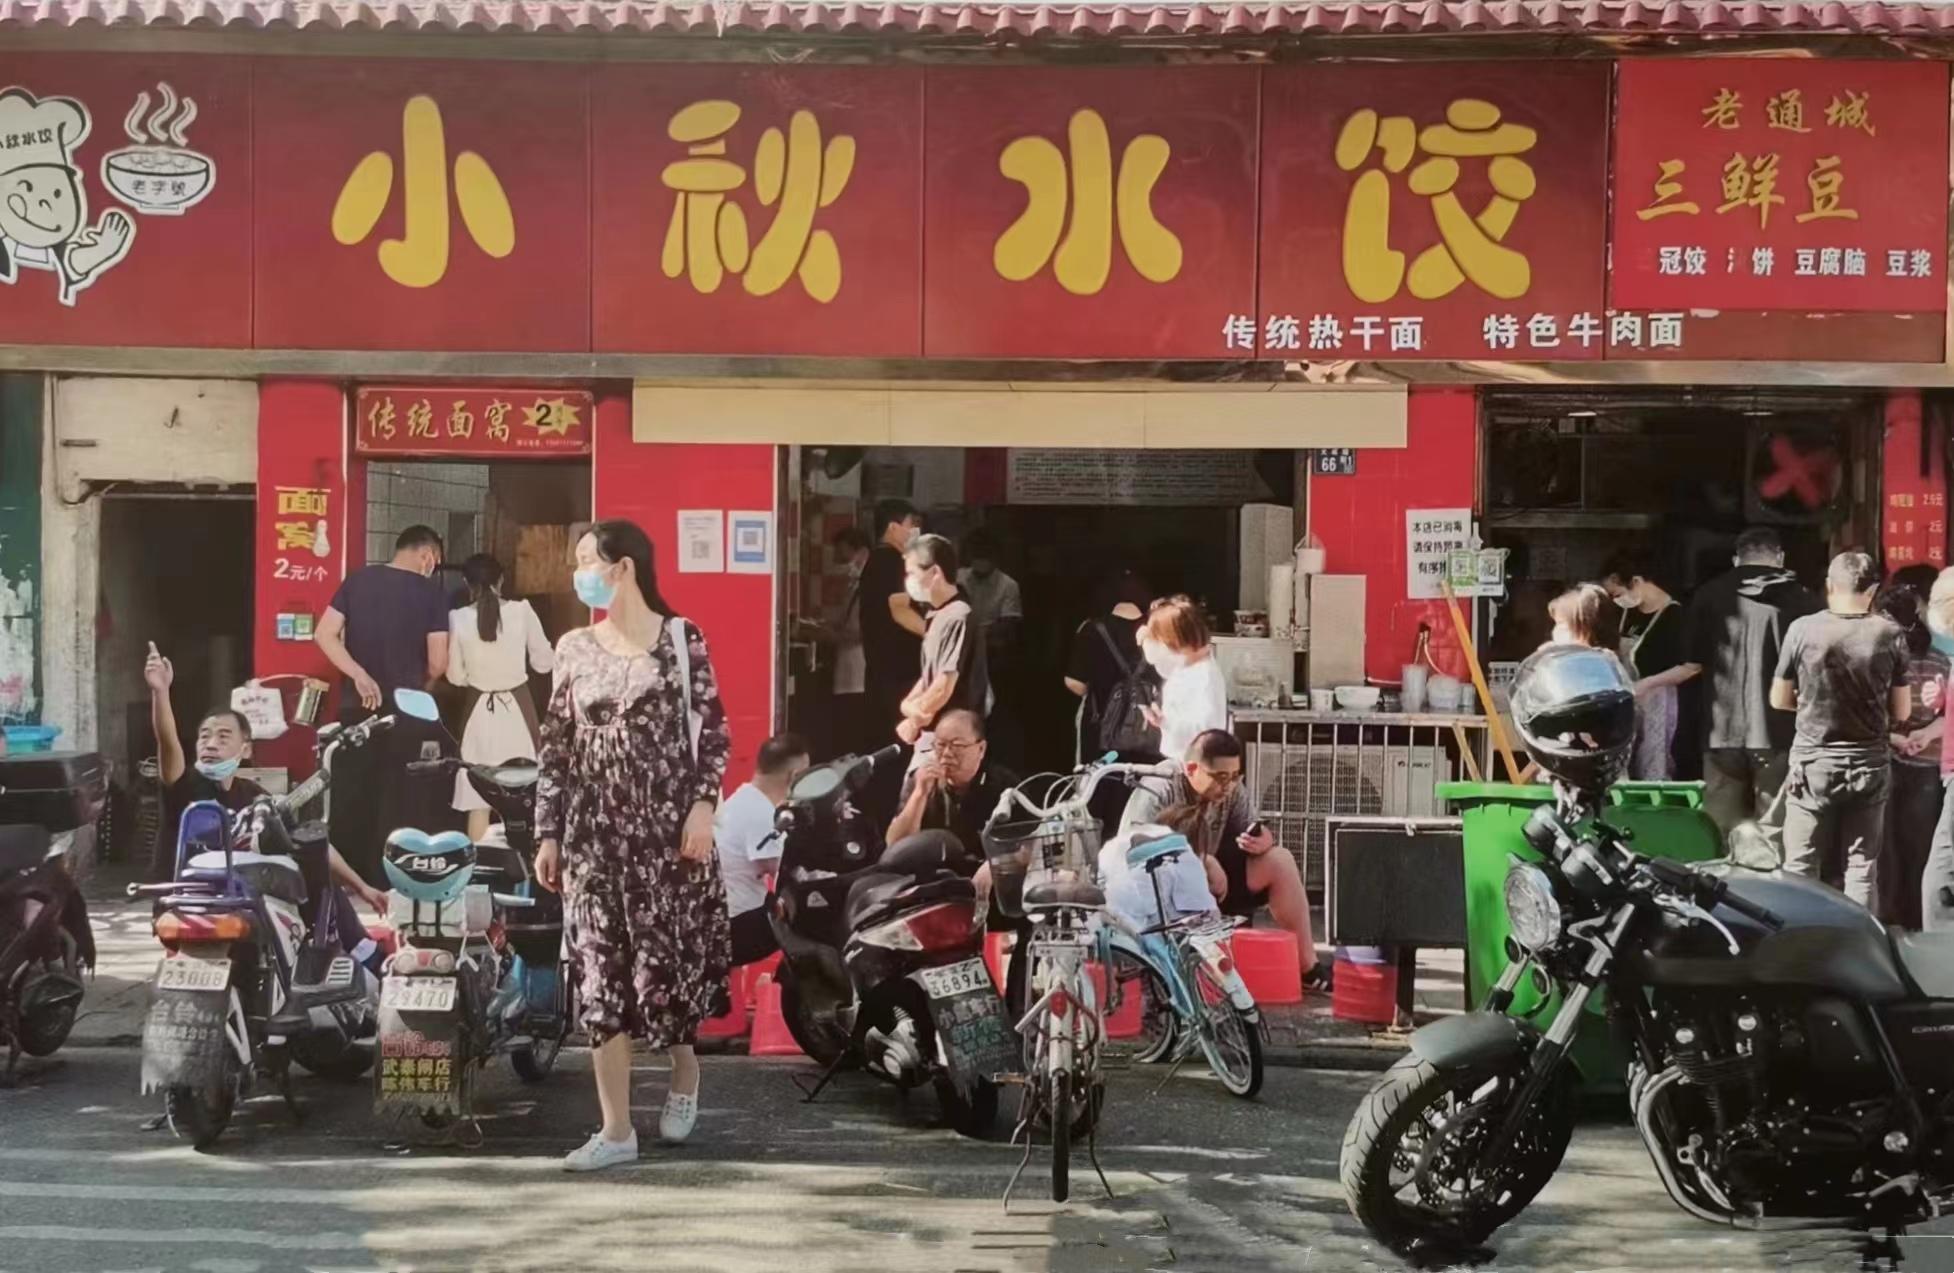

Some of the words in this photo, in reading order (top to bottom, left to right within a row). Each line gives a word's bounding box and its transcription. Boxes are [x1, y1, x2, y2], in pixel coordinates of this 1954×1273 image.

[1702, 88, 1876, 137] 老通城
[1636, 152, 1859, 230] 三鲜豆
[1794, 247, 1867, 276] 豆腐脑
[1885, 248, 1932, 278] 豆浆
[1222, 314, 1424, 351] 传统热干面
[1482, 312, 1684, 349] 特色牛肉面
[368, 396, 513, 443] 传统面窝
[1321, 457, 1337, 472] 66
[273, 558, 328, 582] 2元/个
